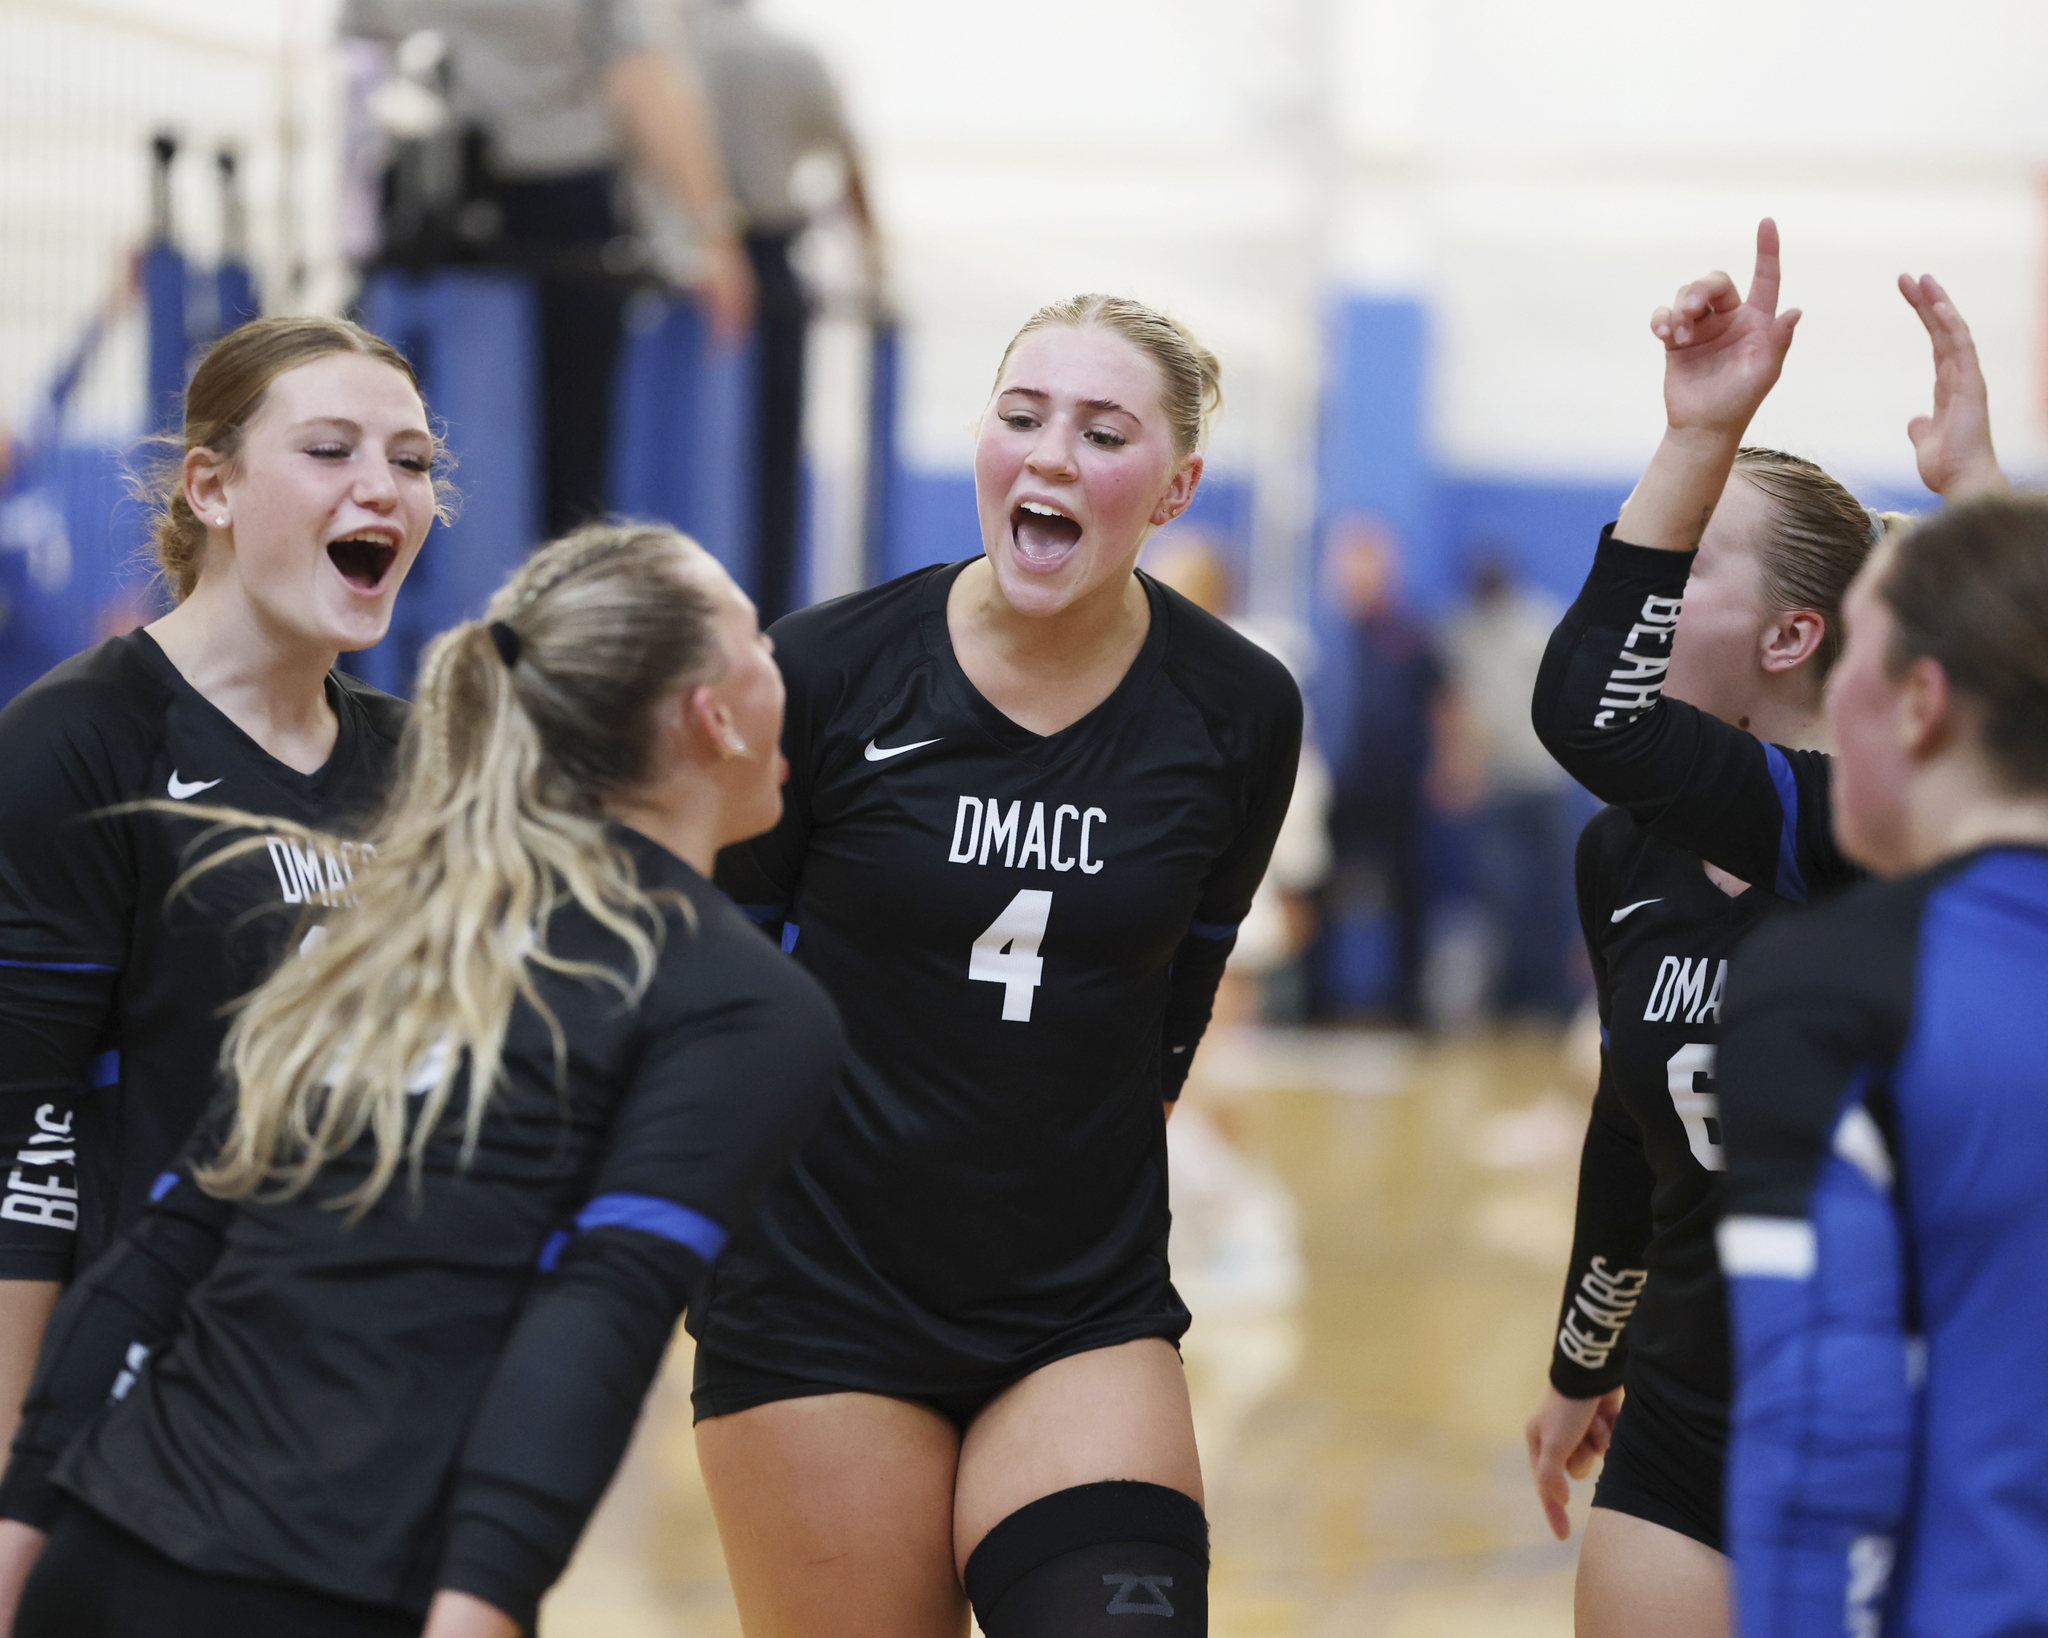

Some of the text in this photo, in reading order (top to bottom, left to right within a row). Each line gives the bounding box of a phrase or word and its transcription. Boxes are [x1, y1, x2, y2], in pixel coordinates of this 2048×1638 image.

[948, 795, 1107, 875] DMACC
[968, 888, 1053, 1023] 4
[1558, 1254, 1649, 1370] BEARS
